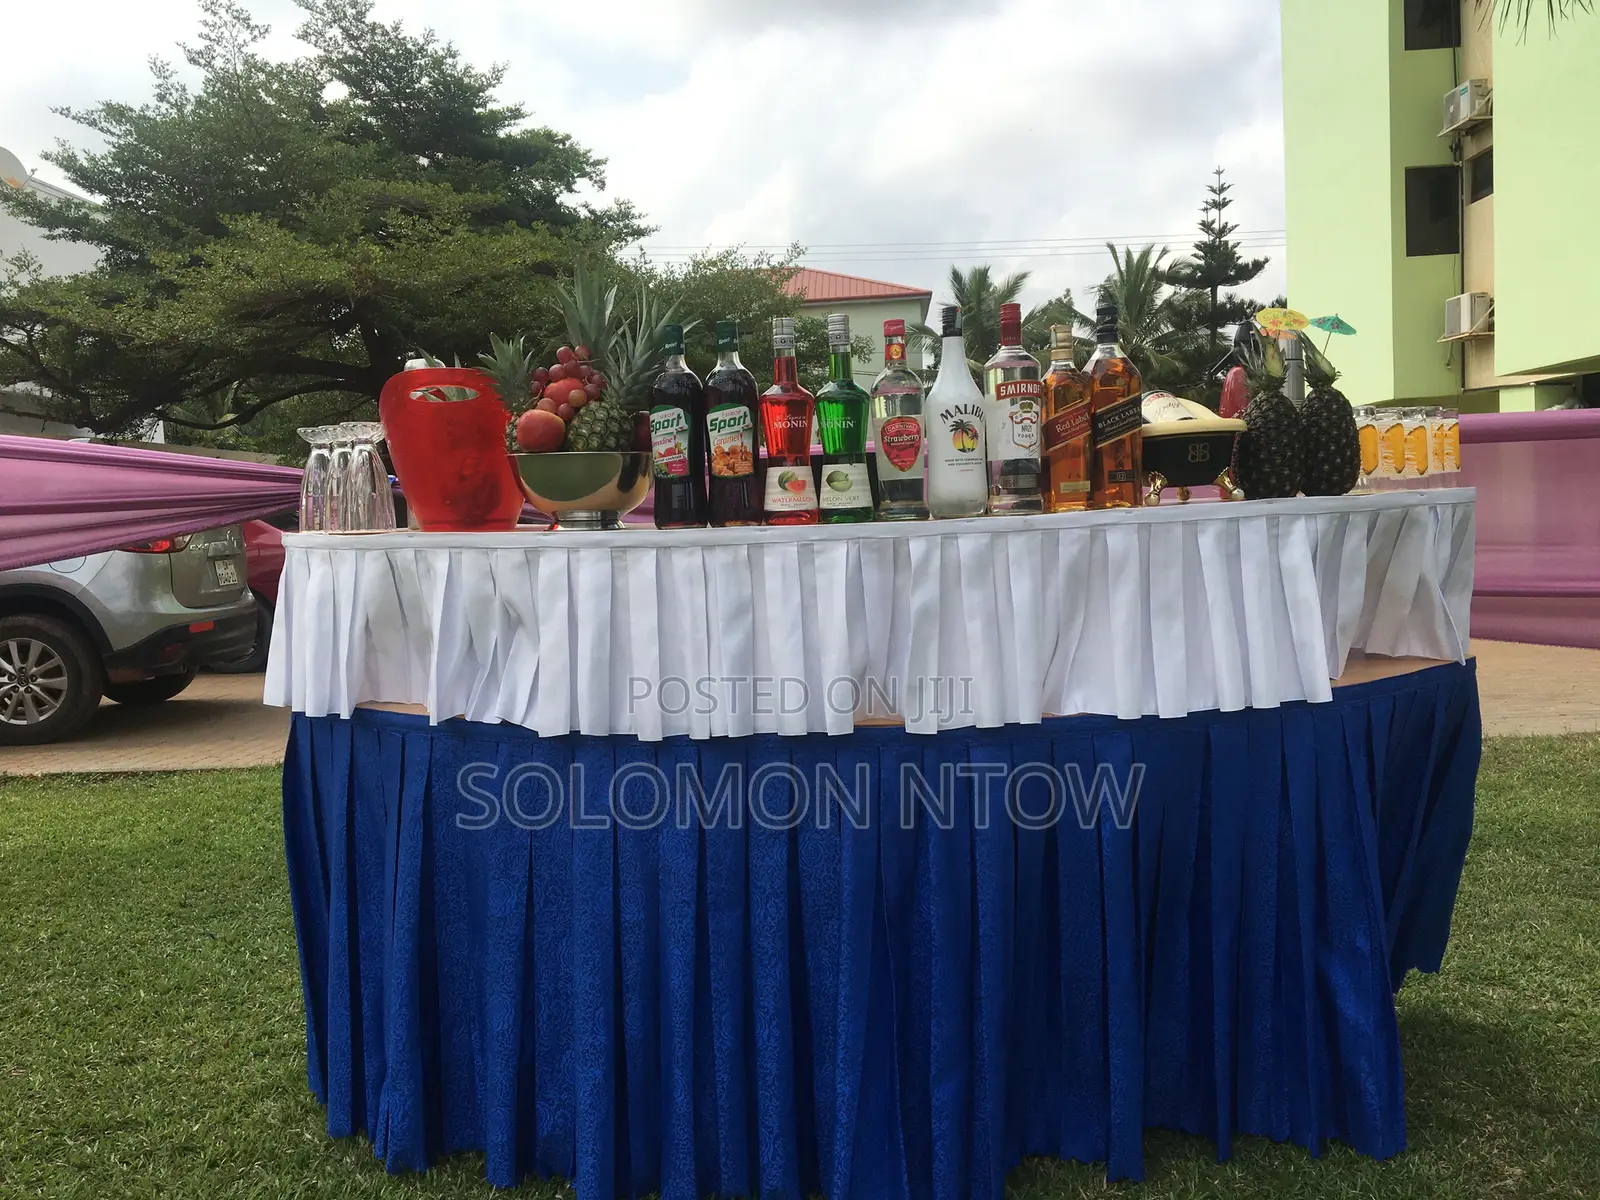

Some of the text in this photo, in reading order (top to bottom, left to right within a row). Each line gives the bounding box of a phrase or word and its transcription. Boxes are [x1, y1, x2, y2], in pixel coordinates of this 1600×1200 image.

[650, 413, 682, 434] Sport
[709, 411, 748, 433] Sport
[940, 403, 985, 424] MALIBU
[1055, 421, 1071, 433] Red
[1072, 412, 1090, 426] Label
[1097, 415, 1120, 429] BLACK
[1121, 406, 1141, 419] LABEL
[773, 420, 808, 429] MONIN
[887, 422, 917, 431] CARNIVAL
[884, 434, 919, 444] Strawberry
